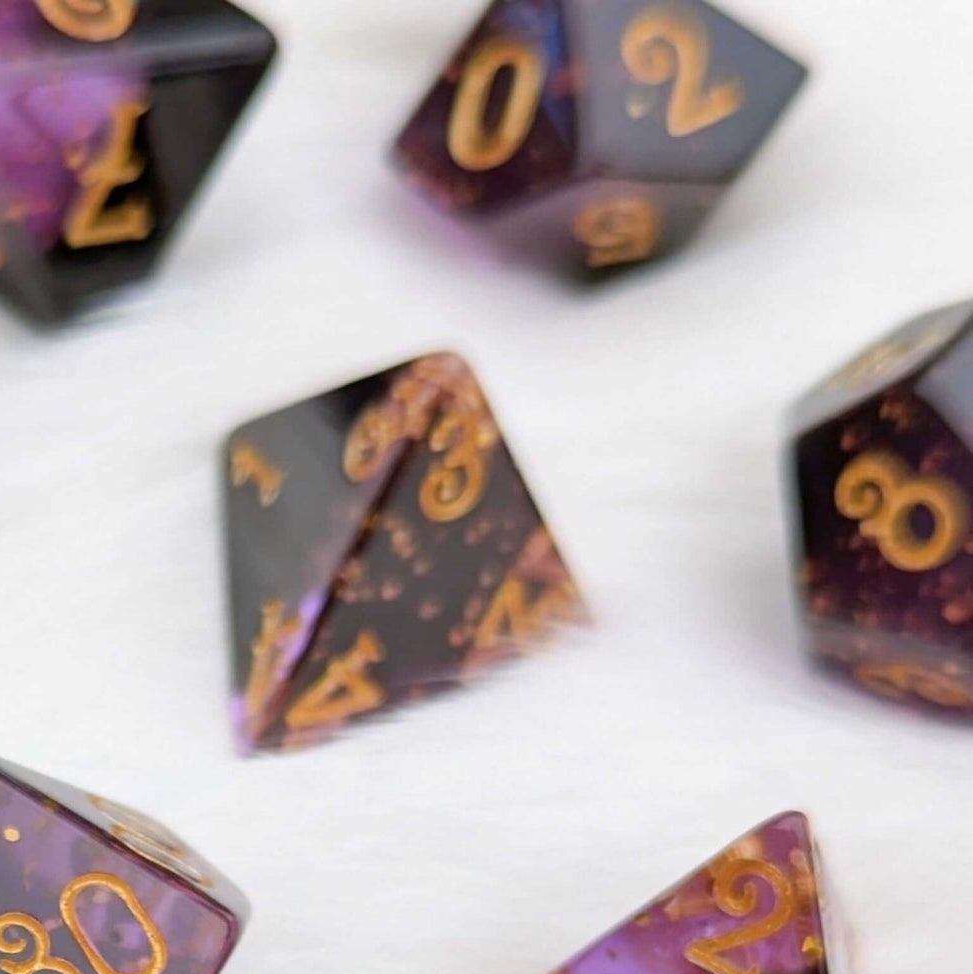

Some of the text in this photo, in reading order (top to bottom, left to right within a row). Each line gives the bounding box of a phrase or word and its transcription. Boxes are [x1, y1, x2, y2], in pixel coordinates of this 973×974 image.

[448, 40, 545, 171] 0
[622, 10, 743, 137] 2
[834, 449, 967, 571] 8
